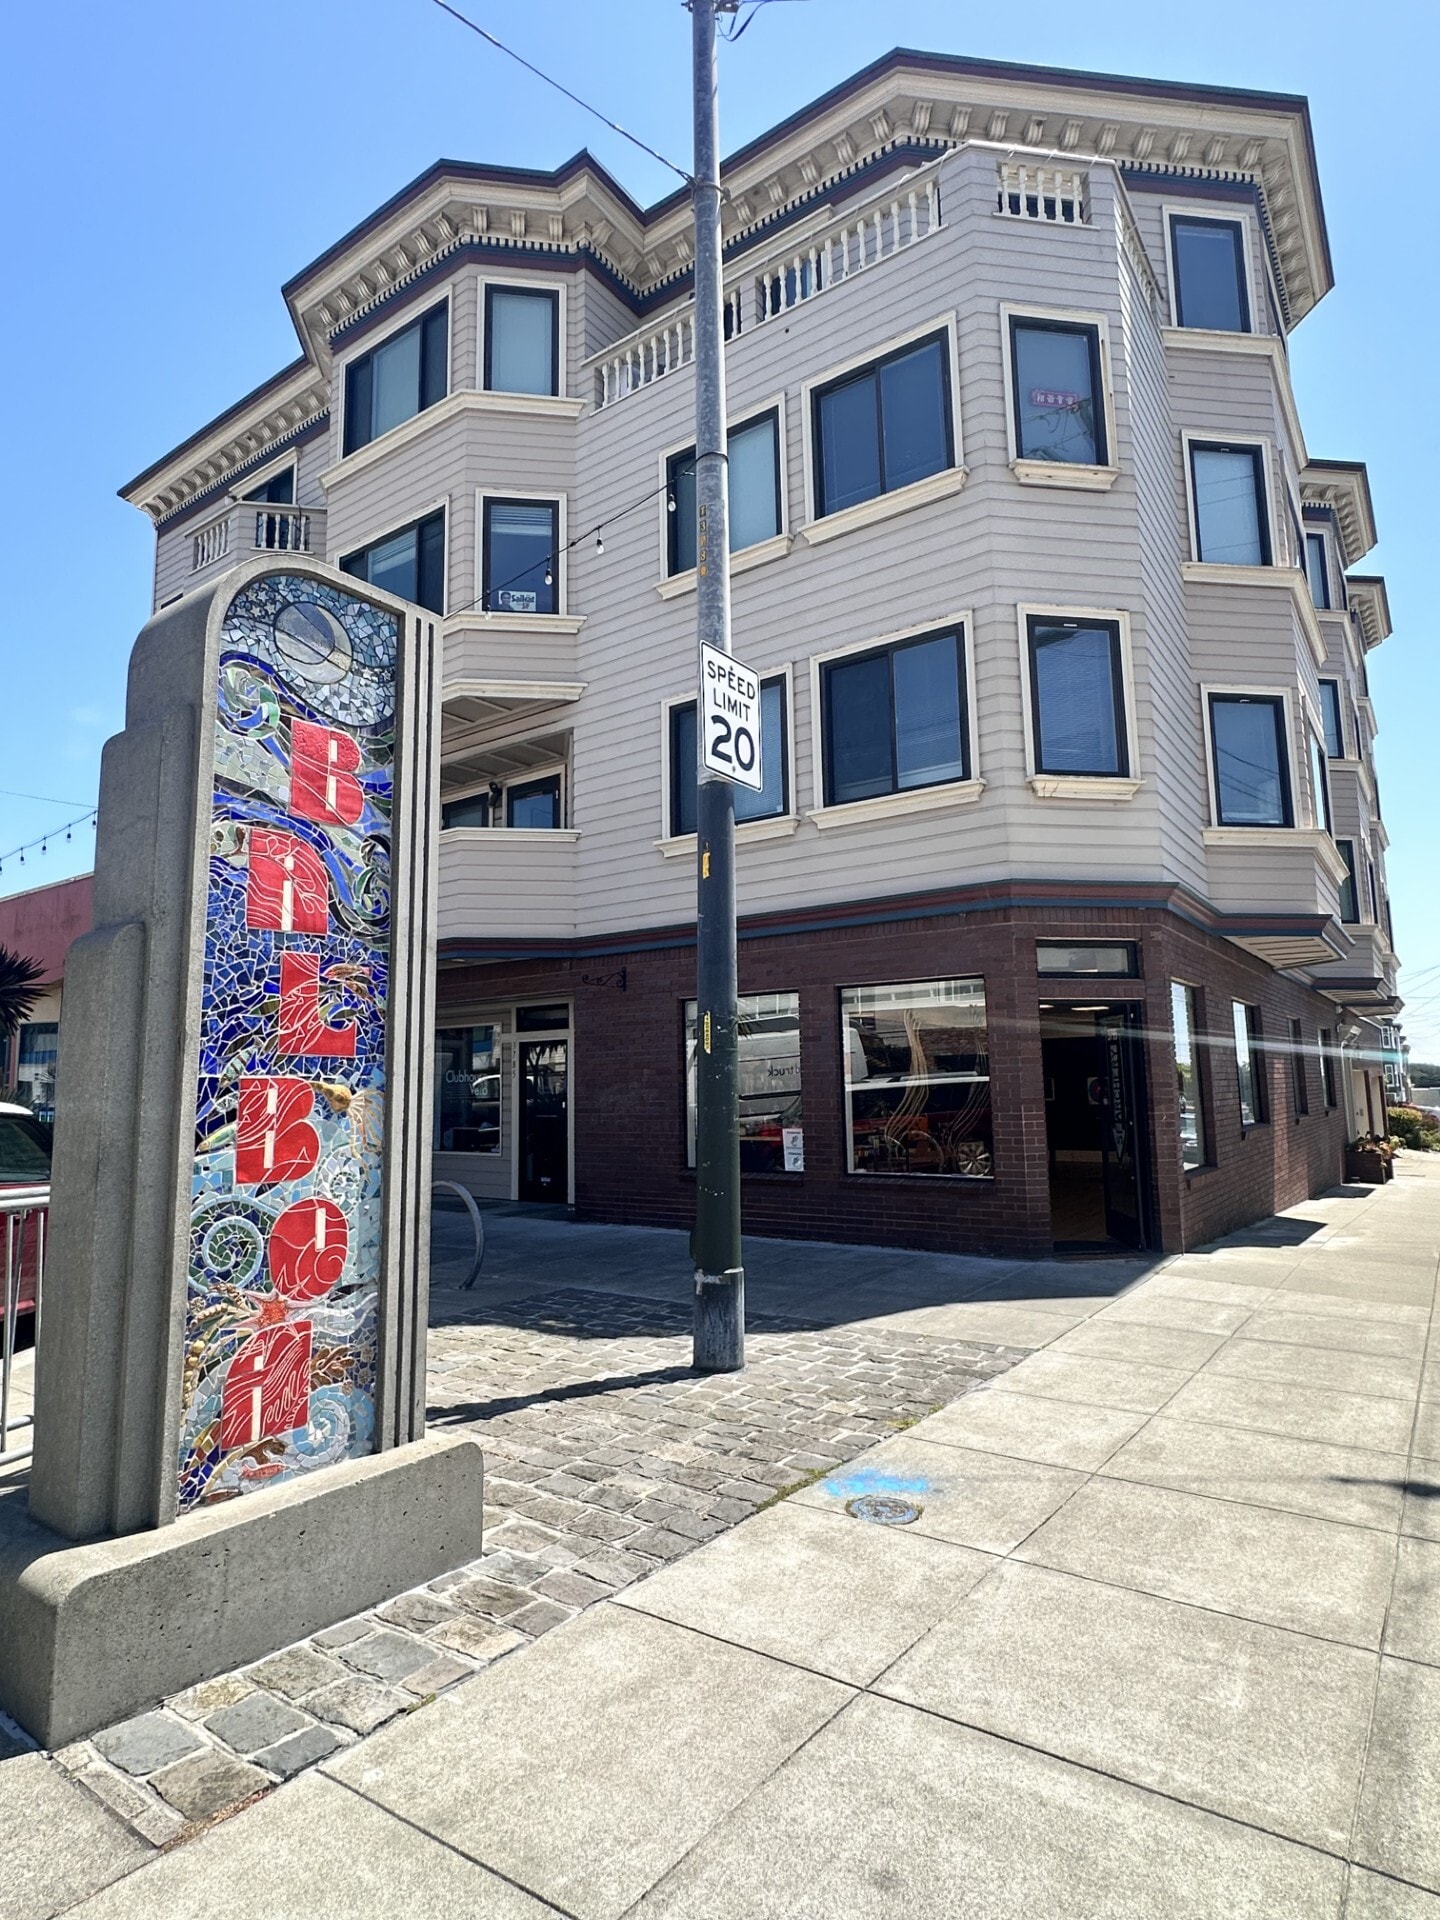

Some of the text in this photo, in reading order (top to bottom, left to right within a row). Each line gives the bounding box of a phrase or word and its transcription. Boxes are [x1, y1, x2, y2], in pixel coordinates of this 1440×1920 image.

[707, 660, 756, 700] SPEED
[713, 687, 751, 722] LIMIT
[711, 714, 755, 772] 20
[220, 716, 365, 1450] BALBOA
